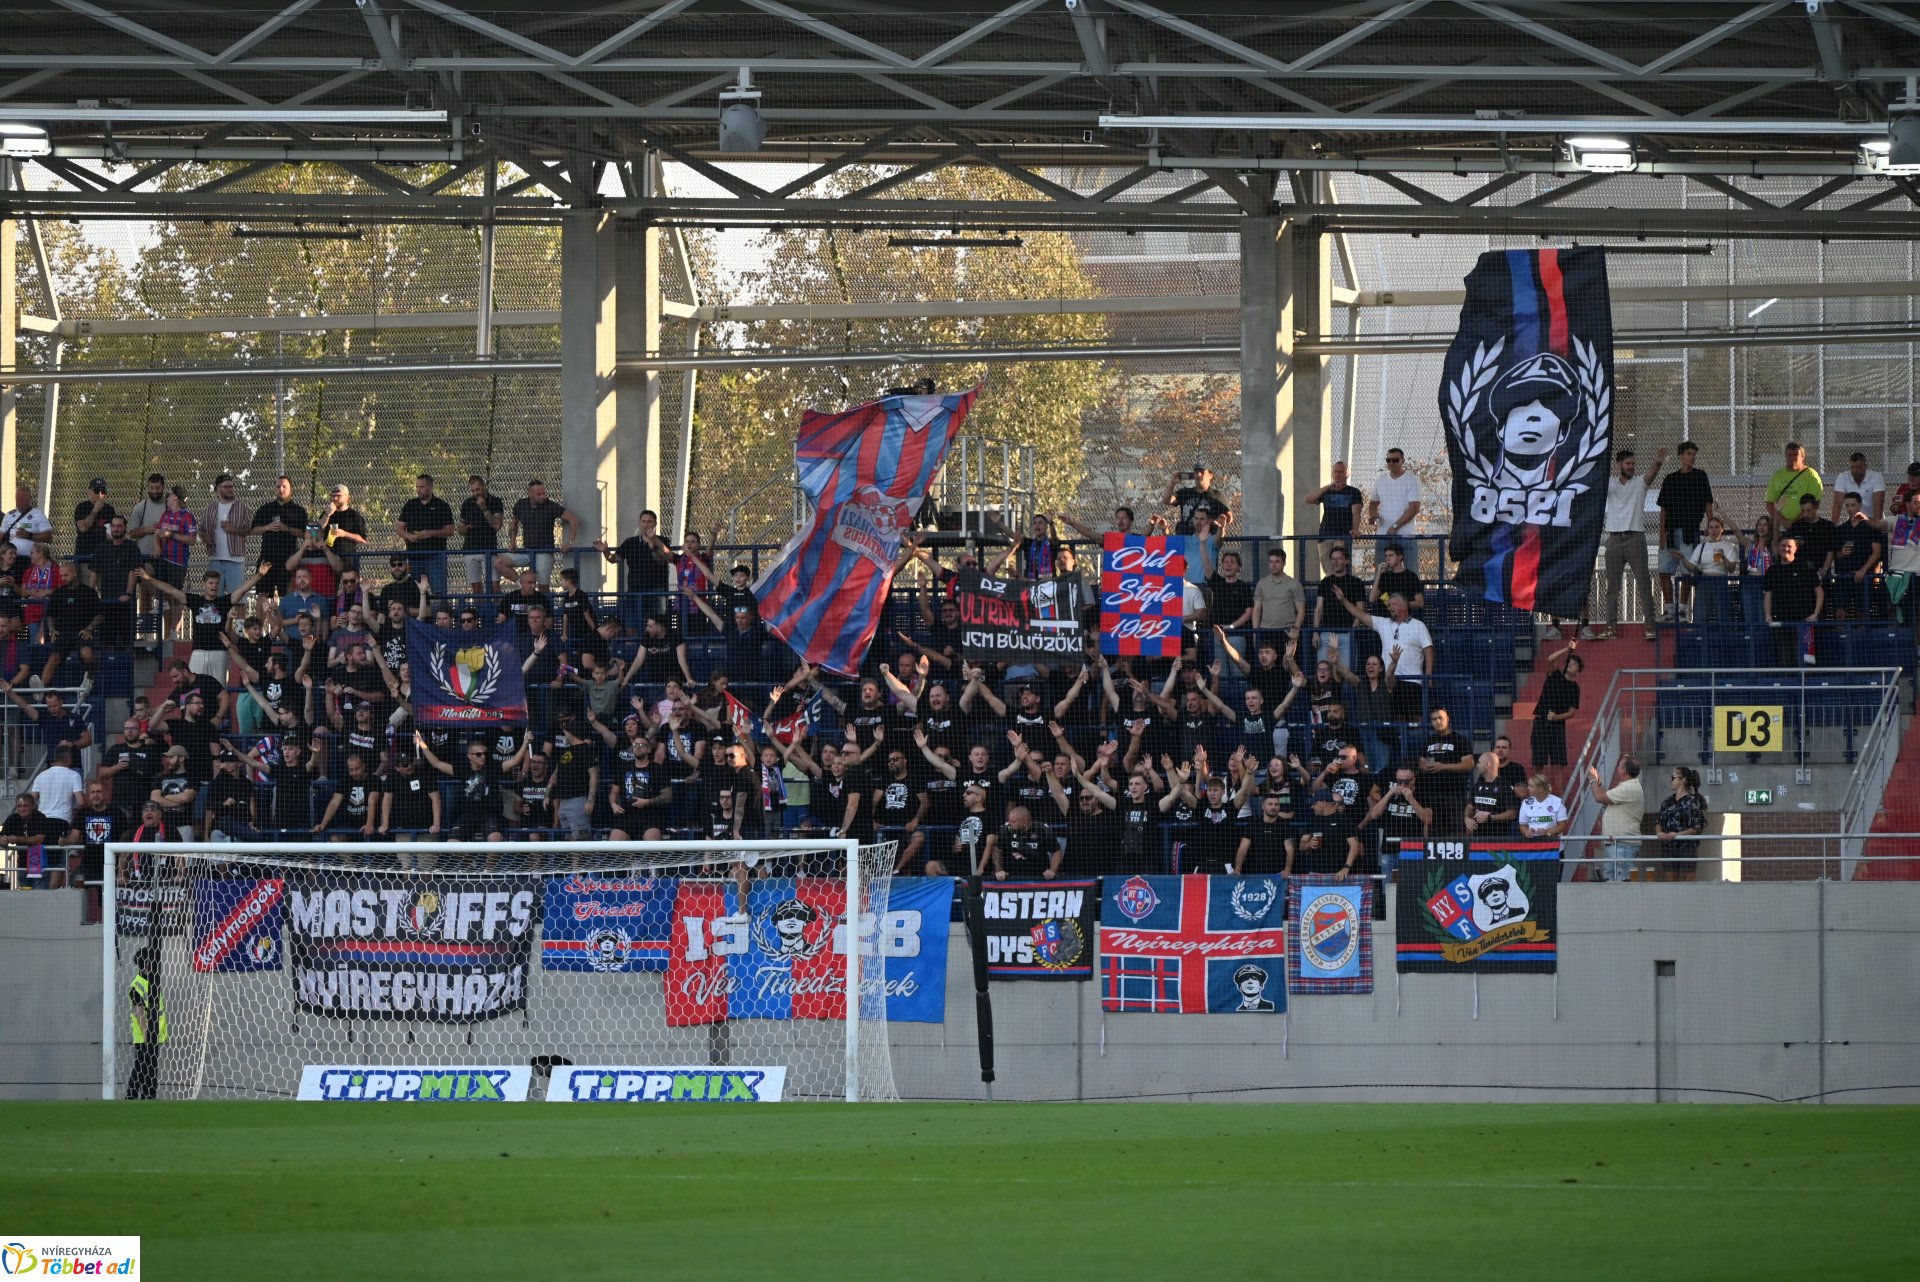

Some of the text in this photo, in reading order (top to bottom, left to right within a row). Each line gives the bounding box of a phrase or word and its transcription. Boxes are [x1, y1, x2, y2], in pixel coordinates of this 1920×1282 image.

[1112, 546, 1178, 571] Old
[1105, 578, 1177, 612] Style
[1110, 618, 1172, 639] 1992
[1726, 710, 1771, 747] D3
[1427, 842, 1464, 859] 1928
[564, 876, 654, 895] Special
[1454, 882, 1471, 903] S
[980, 890, 1084, 919] ASTERN
[1241, 893, 1267, 902] 1928
[573, 901, 646, 921] Guests
[1431, 895, 1455, 922] NY
[1033, 925, 1056, 942] NY S
[1457, 918, 1472, 940] F
[1042, 945, 1048, 958] F
[1109, 932, 1277, 955] Nyíregyháza
[298, 963, 523, 1015] NYÍREGYHÁZA
